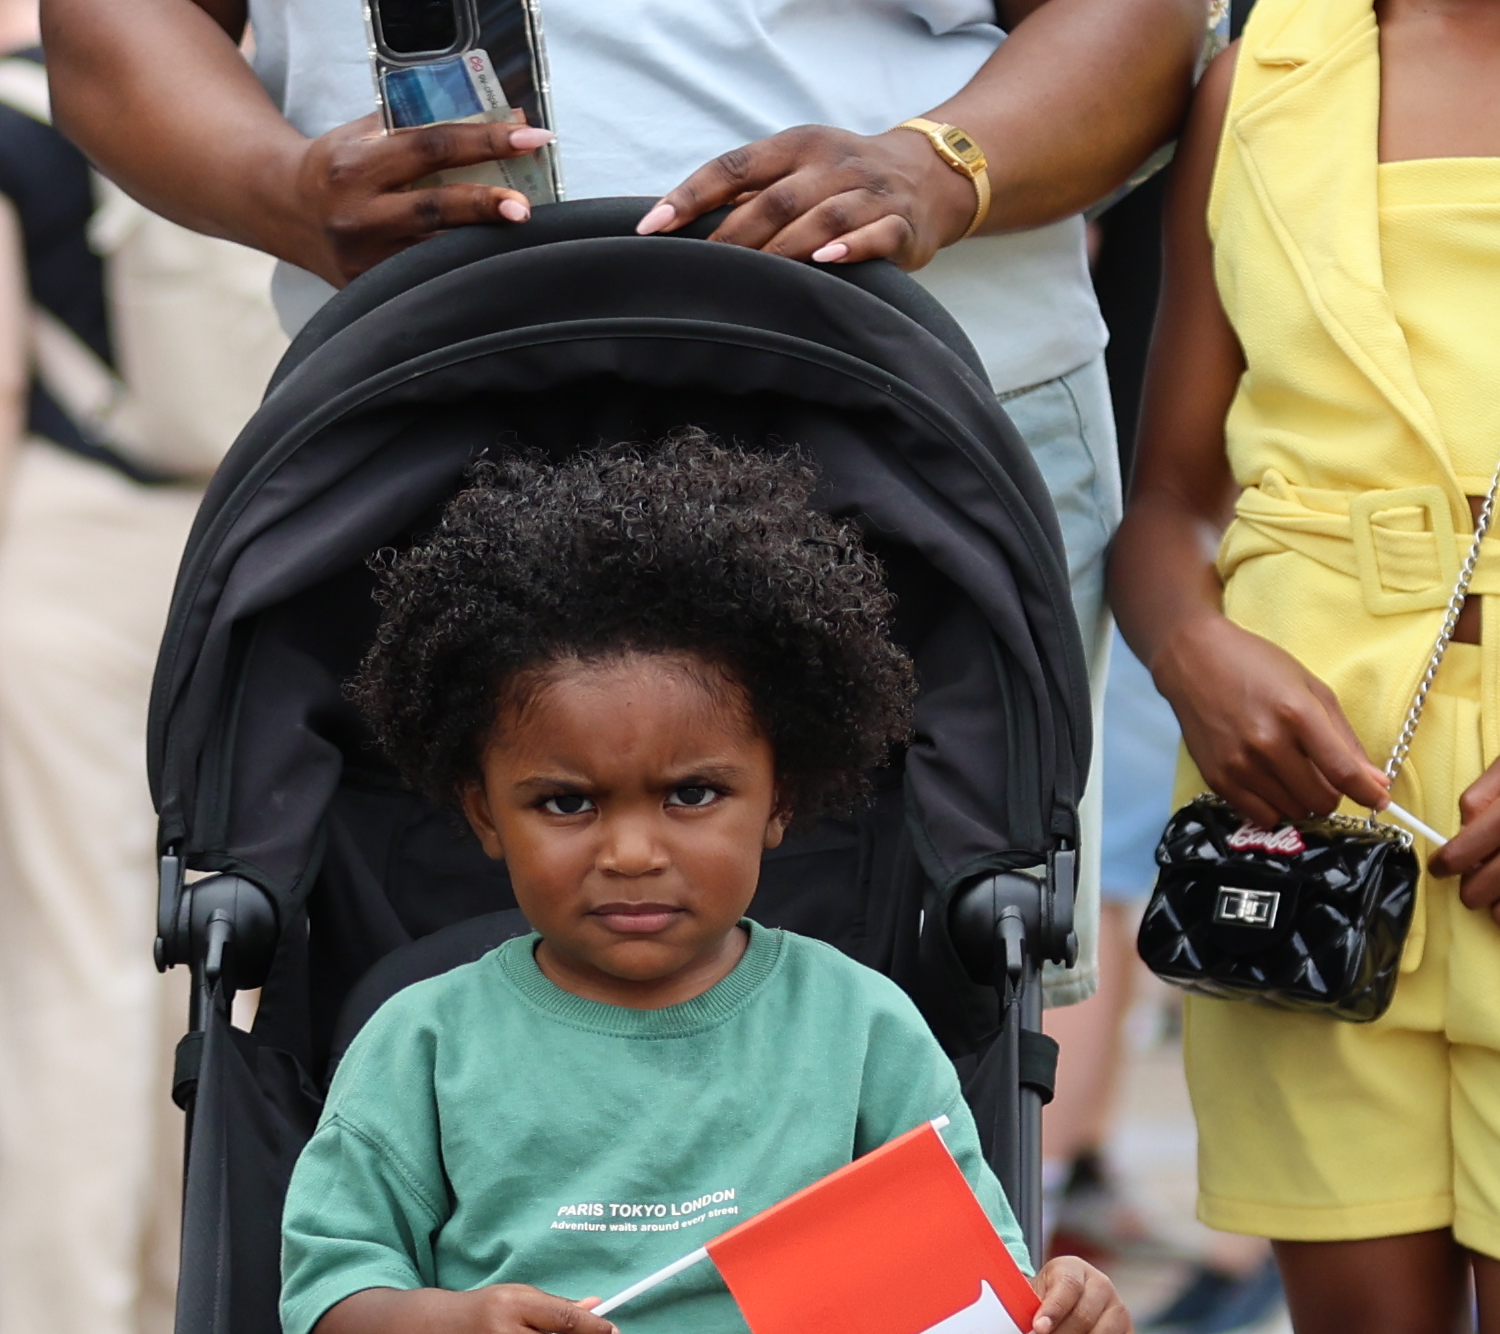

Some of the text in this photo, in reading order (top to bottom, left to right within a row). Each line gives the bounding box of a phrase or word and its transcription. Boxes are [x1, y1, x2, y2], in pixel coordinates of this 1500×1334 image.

[557, 1188, 736, 1218] PARIS TOKYO LONDON
[550, 1205, 739, 1232] Adventure waits around every street
